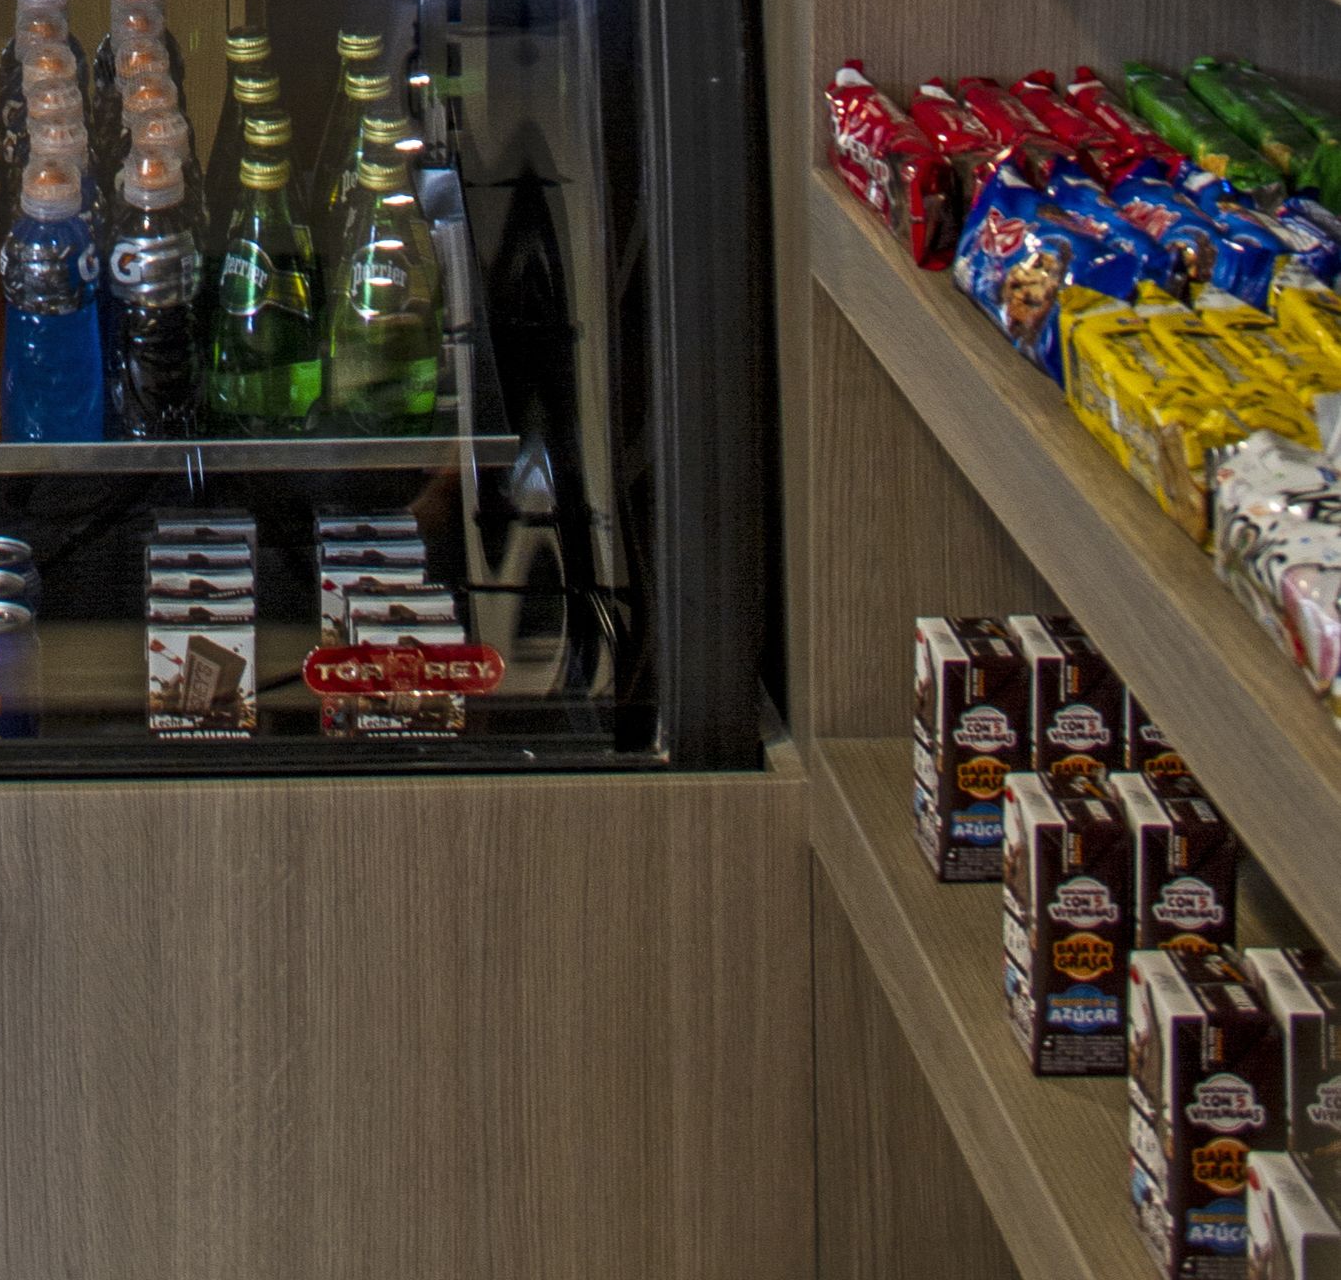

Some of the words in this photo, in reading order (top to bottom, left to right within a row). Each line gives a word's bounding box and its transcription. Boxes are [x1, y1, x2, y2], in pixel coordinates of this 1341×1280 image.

[111, 242, 145, 284] G
[966, 723, 990, 733] CON
[993, 722, 1002, 733] 5
[1060, 721, 1085, 731] CON
[1088, 720, 1097, 731] 5
[961, 763, 992, 775] BAJA
[952, 820, 1003, 837] AZÚCA
[1063, 896, 1090, 907] CON
[1093, 895, 1103, 908] 5
[1167, 896, 1194, 907] CON
[1197, 896, 1207, 908] 5
[1056, 942, 1091, 954] BAJA
[1092, 942, 1109, 954] EN
[1058, 956, 1113, 969] GRASA
[1048, 1005, 1119, 1023] AZÚCAR
[1202, 1095, 1232, 1107] CON
[1235, 1095, 1246, 1108] 5
[1195, 1149, 1232, 1161] BAJA
